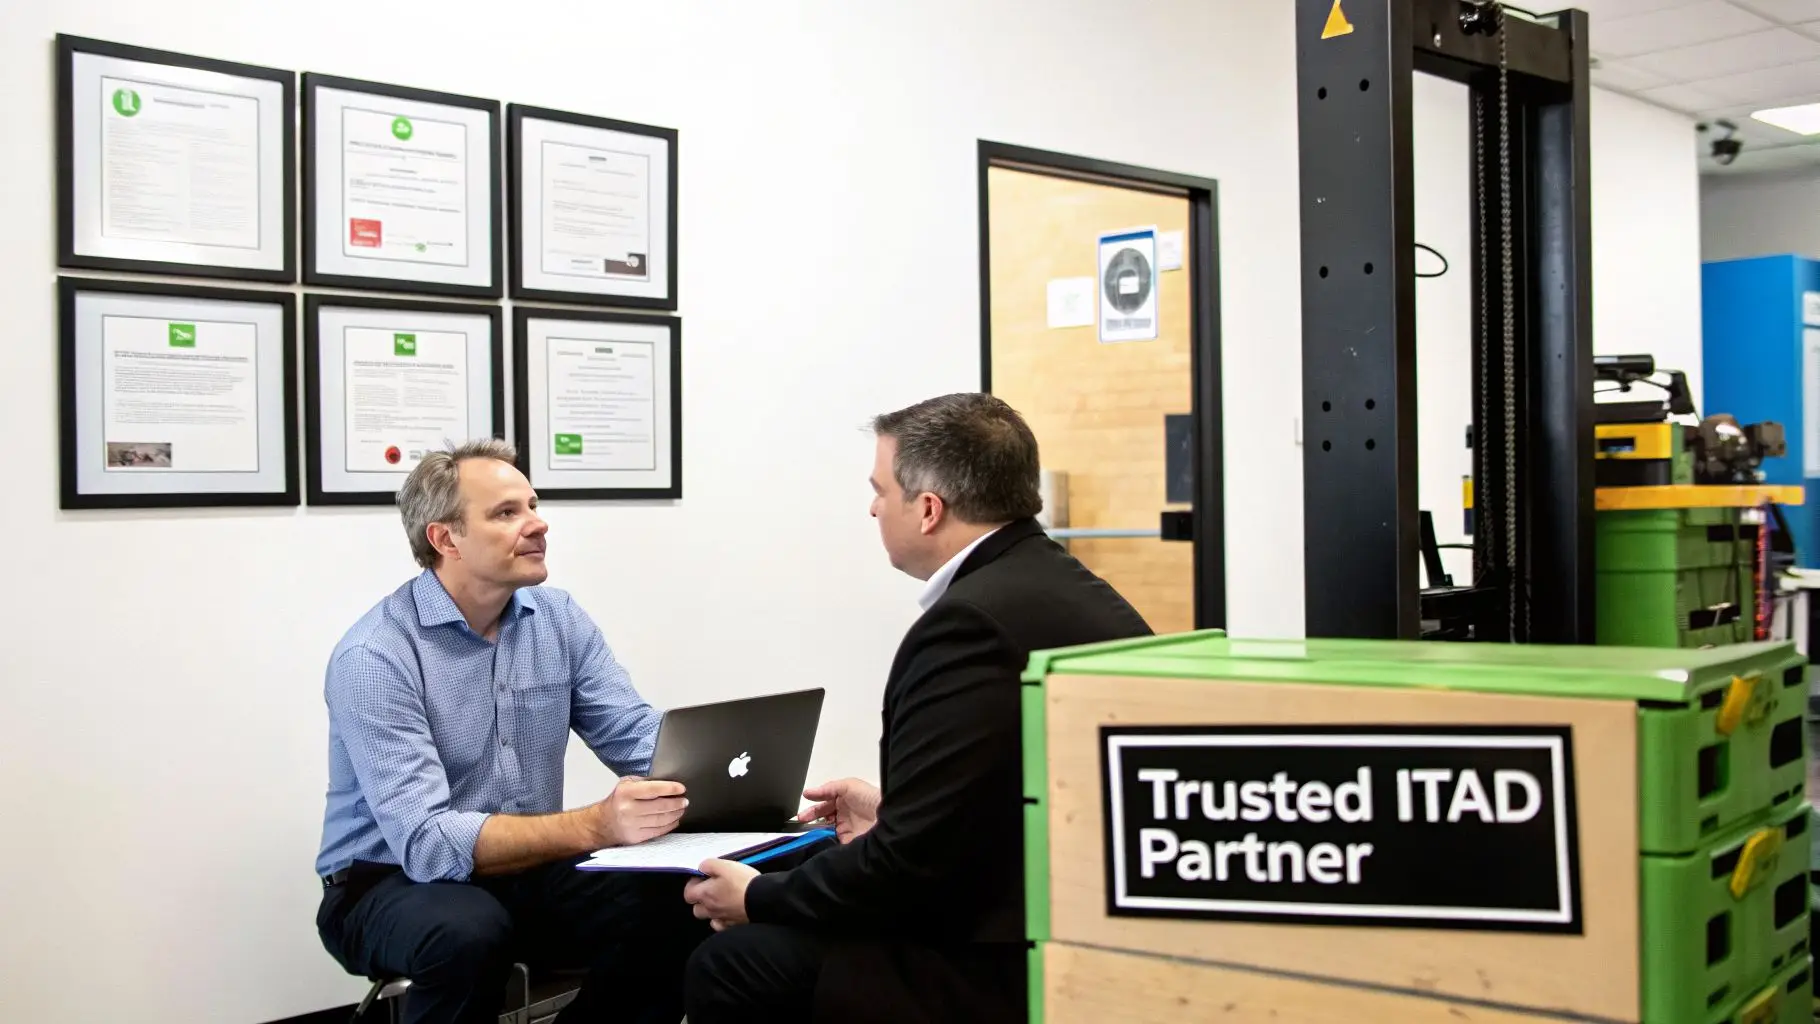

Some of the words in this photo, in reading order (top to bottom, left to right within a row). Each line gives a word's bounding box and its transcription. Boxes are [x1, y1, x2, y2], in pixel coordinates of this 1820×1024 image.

[1138, 766, 1373, 822] Trusted
[1396, 768, 1542, 823] ITAD
[1139, 828, 1373, 884] Partner
